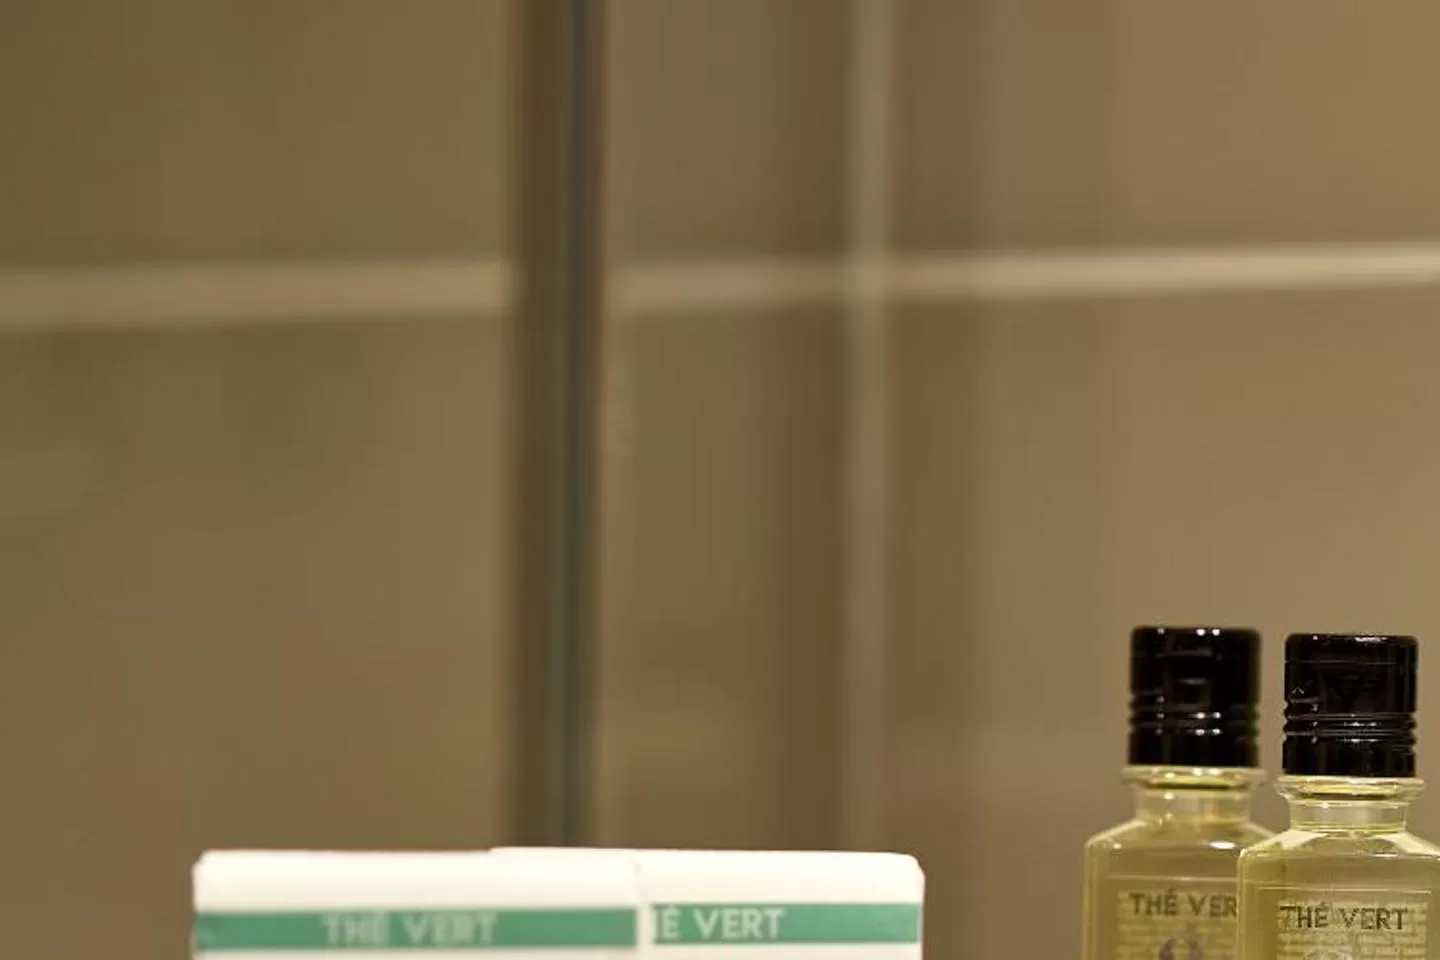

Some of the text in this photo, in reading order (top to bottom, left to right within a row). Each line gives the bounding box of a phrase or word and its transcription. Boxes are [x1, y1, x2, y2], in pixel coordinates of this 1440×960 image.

[1129, 888, 1237, 918] THÉ VER
[1280, 901, 1408, 930] THÉ VERT
[404, 911, 498, 945] VERT
[692, 908, 785, 939] VERT
